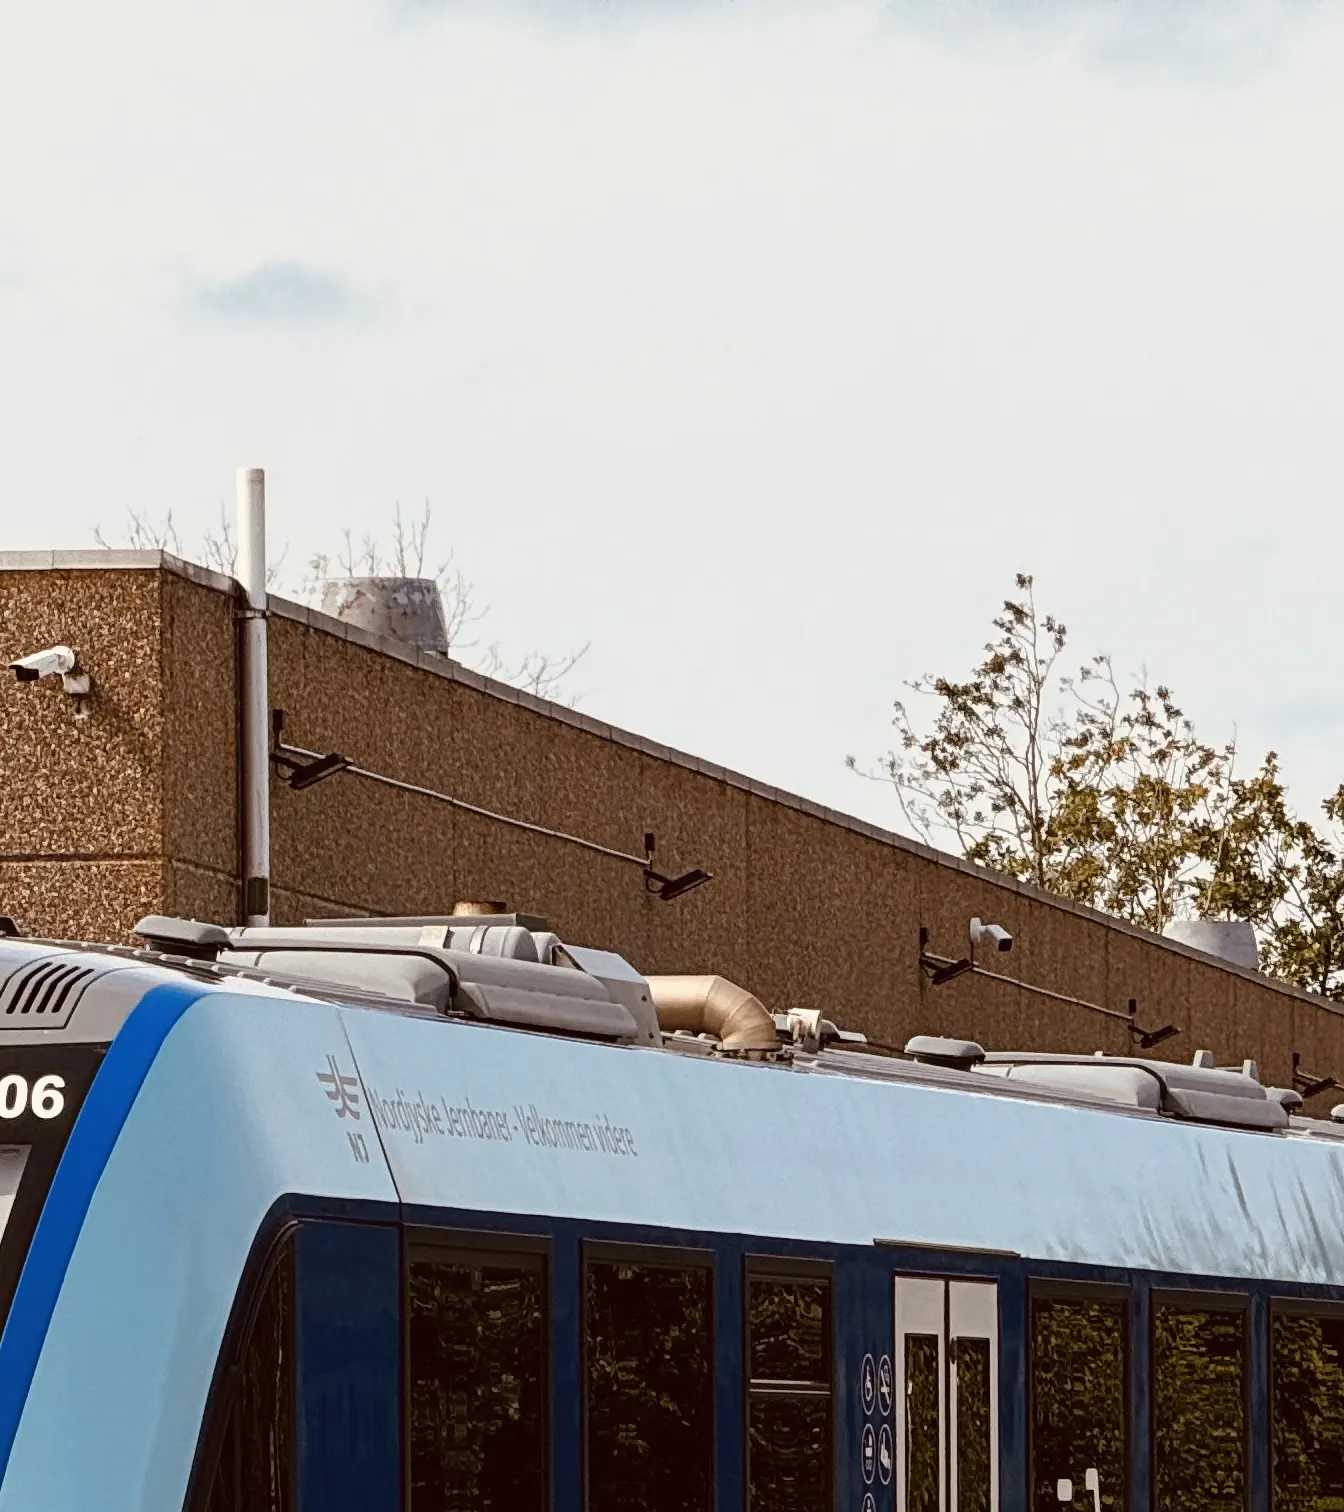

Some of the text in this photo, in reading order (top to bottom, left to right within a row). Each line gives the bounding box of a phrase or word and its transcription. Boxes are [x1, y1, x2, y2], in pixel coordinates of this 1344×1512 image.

[346, 1131, 370, 1163] NJ
[367, 1087, 445, 1145] Nordjyske
[440, 1095, 513, 1142] Jernbaner
[513, 1103, 598, 1152] Velkommen
[593, 1113, 639, 1157] videre
